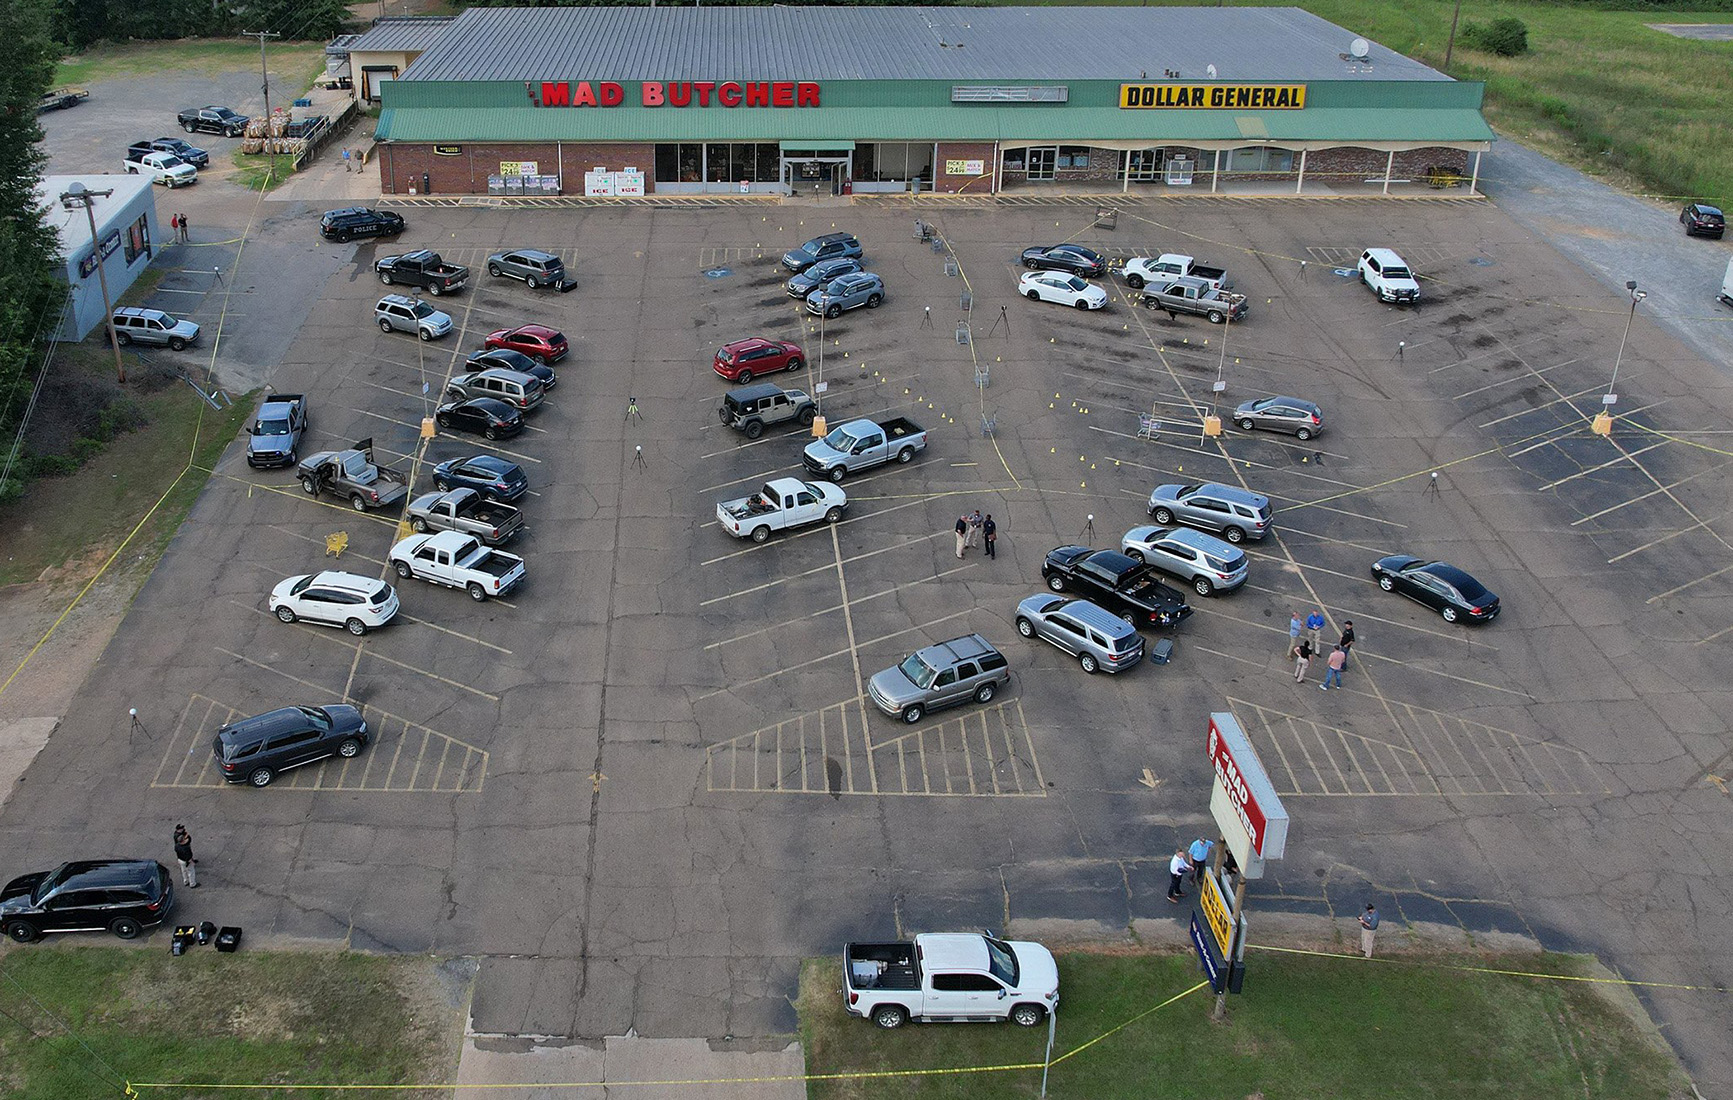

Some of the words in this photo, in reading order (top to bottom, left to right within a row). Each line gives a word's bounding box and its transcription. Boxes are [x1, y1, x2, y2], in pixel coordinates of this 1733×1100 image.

[541, 81, 624, 107] MAD
[641, 81, 821, 108] BUTCHER
[1126, 86, 1205, 107] DOLLAR
[1210, 87, 1301, 108] GENERAL
[353, 225, 378, 233] POLICE
[1226, 759, 1249, 805] MAD
[1215, 756, 1257, 846] BUTCHER
